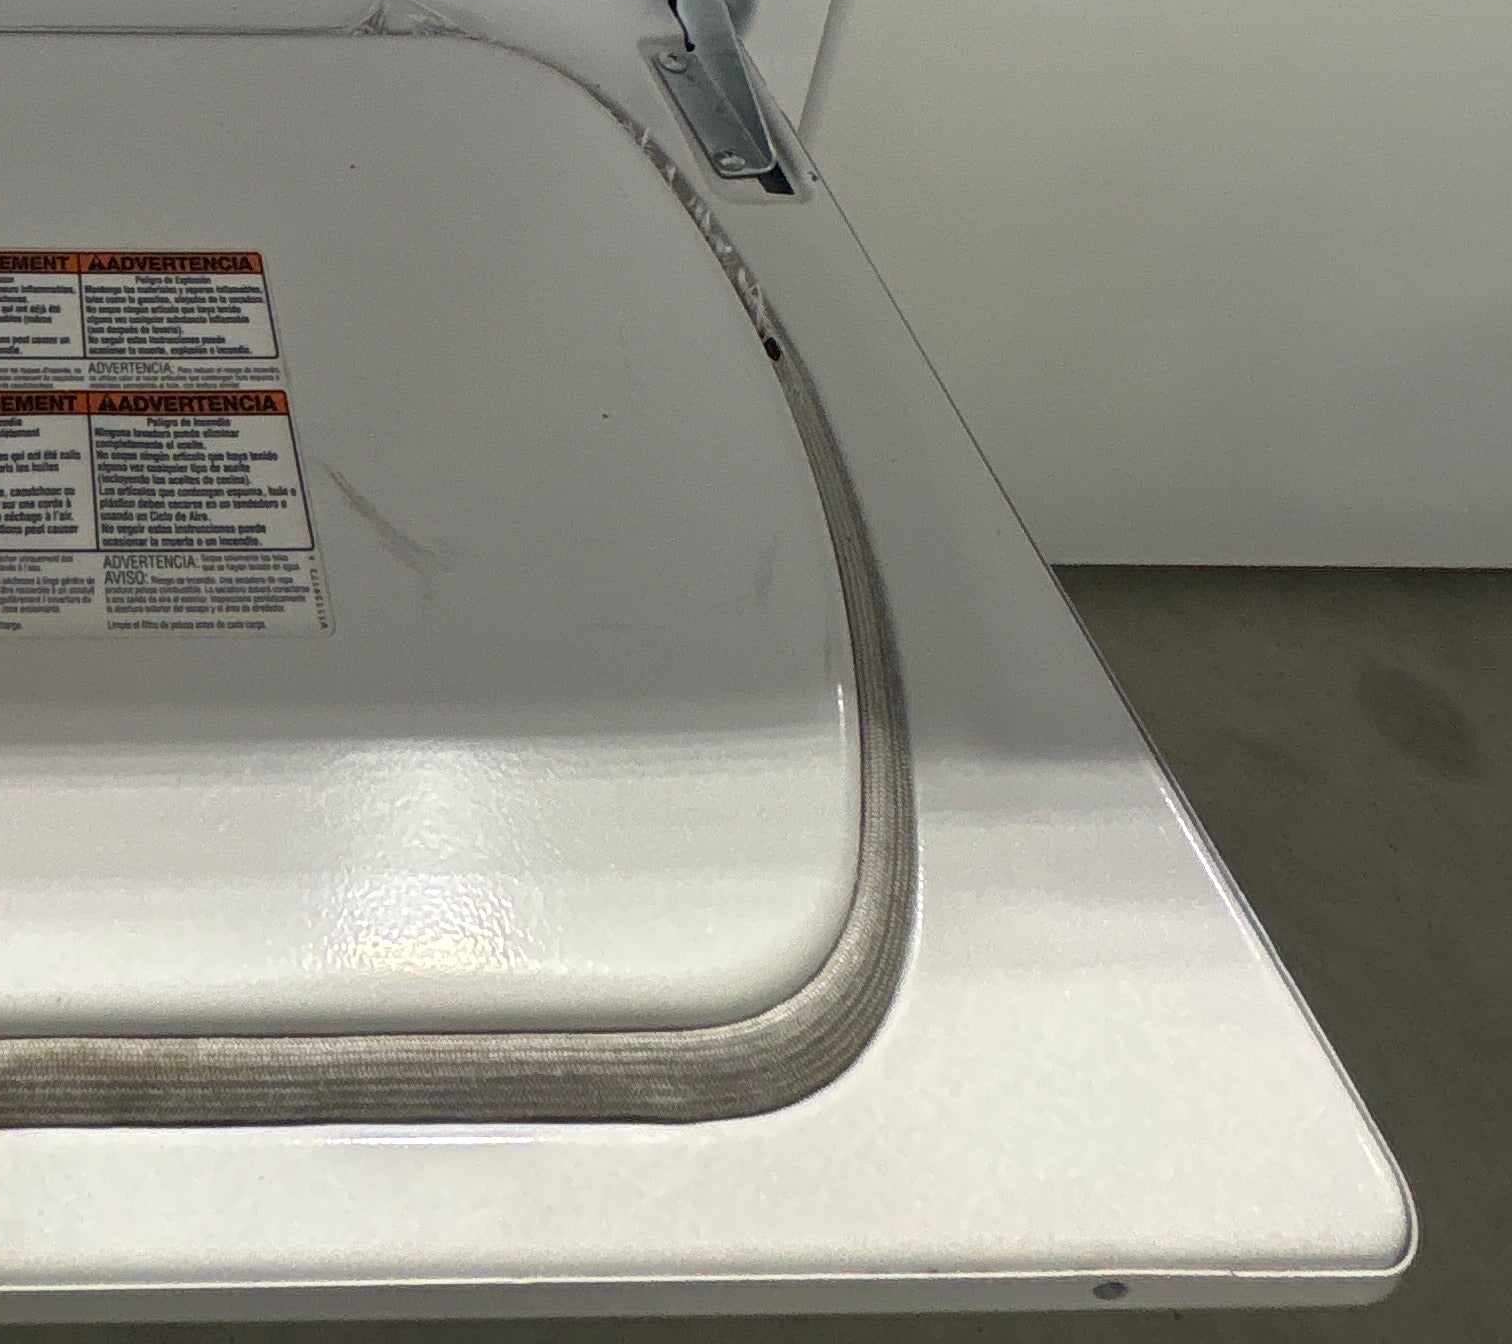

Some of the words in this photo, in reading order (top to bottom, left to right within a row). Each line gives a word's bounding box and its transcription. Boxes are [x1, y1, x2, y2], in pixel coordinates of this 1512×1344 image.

[107, 256, 253, 271] ADVERTENCIA
[118, 395, 278, 412] ADVERTENCIA
[103, 555, 200, 570] ADVERTENCIA:
[104, 571, 148, 585] AVISO:
